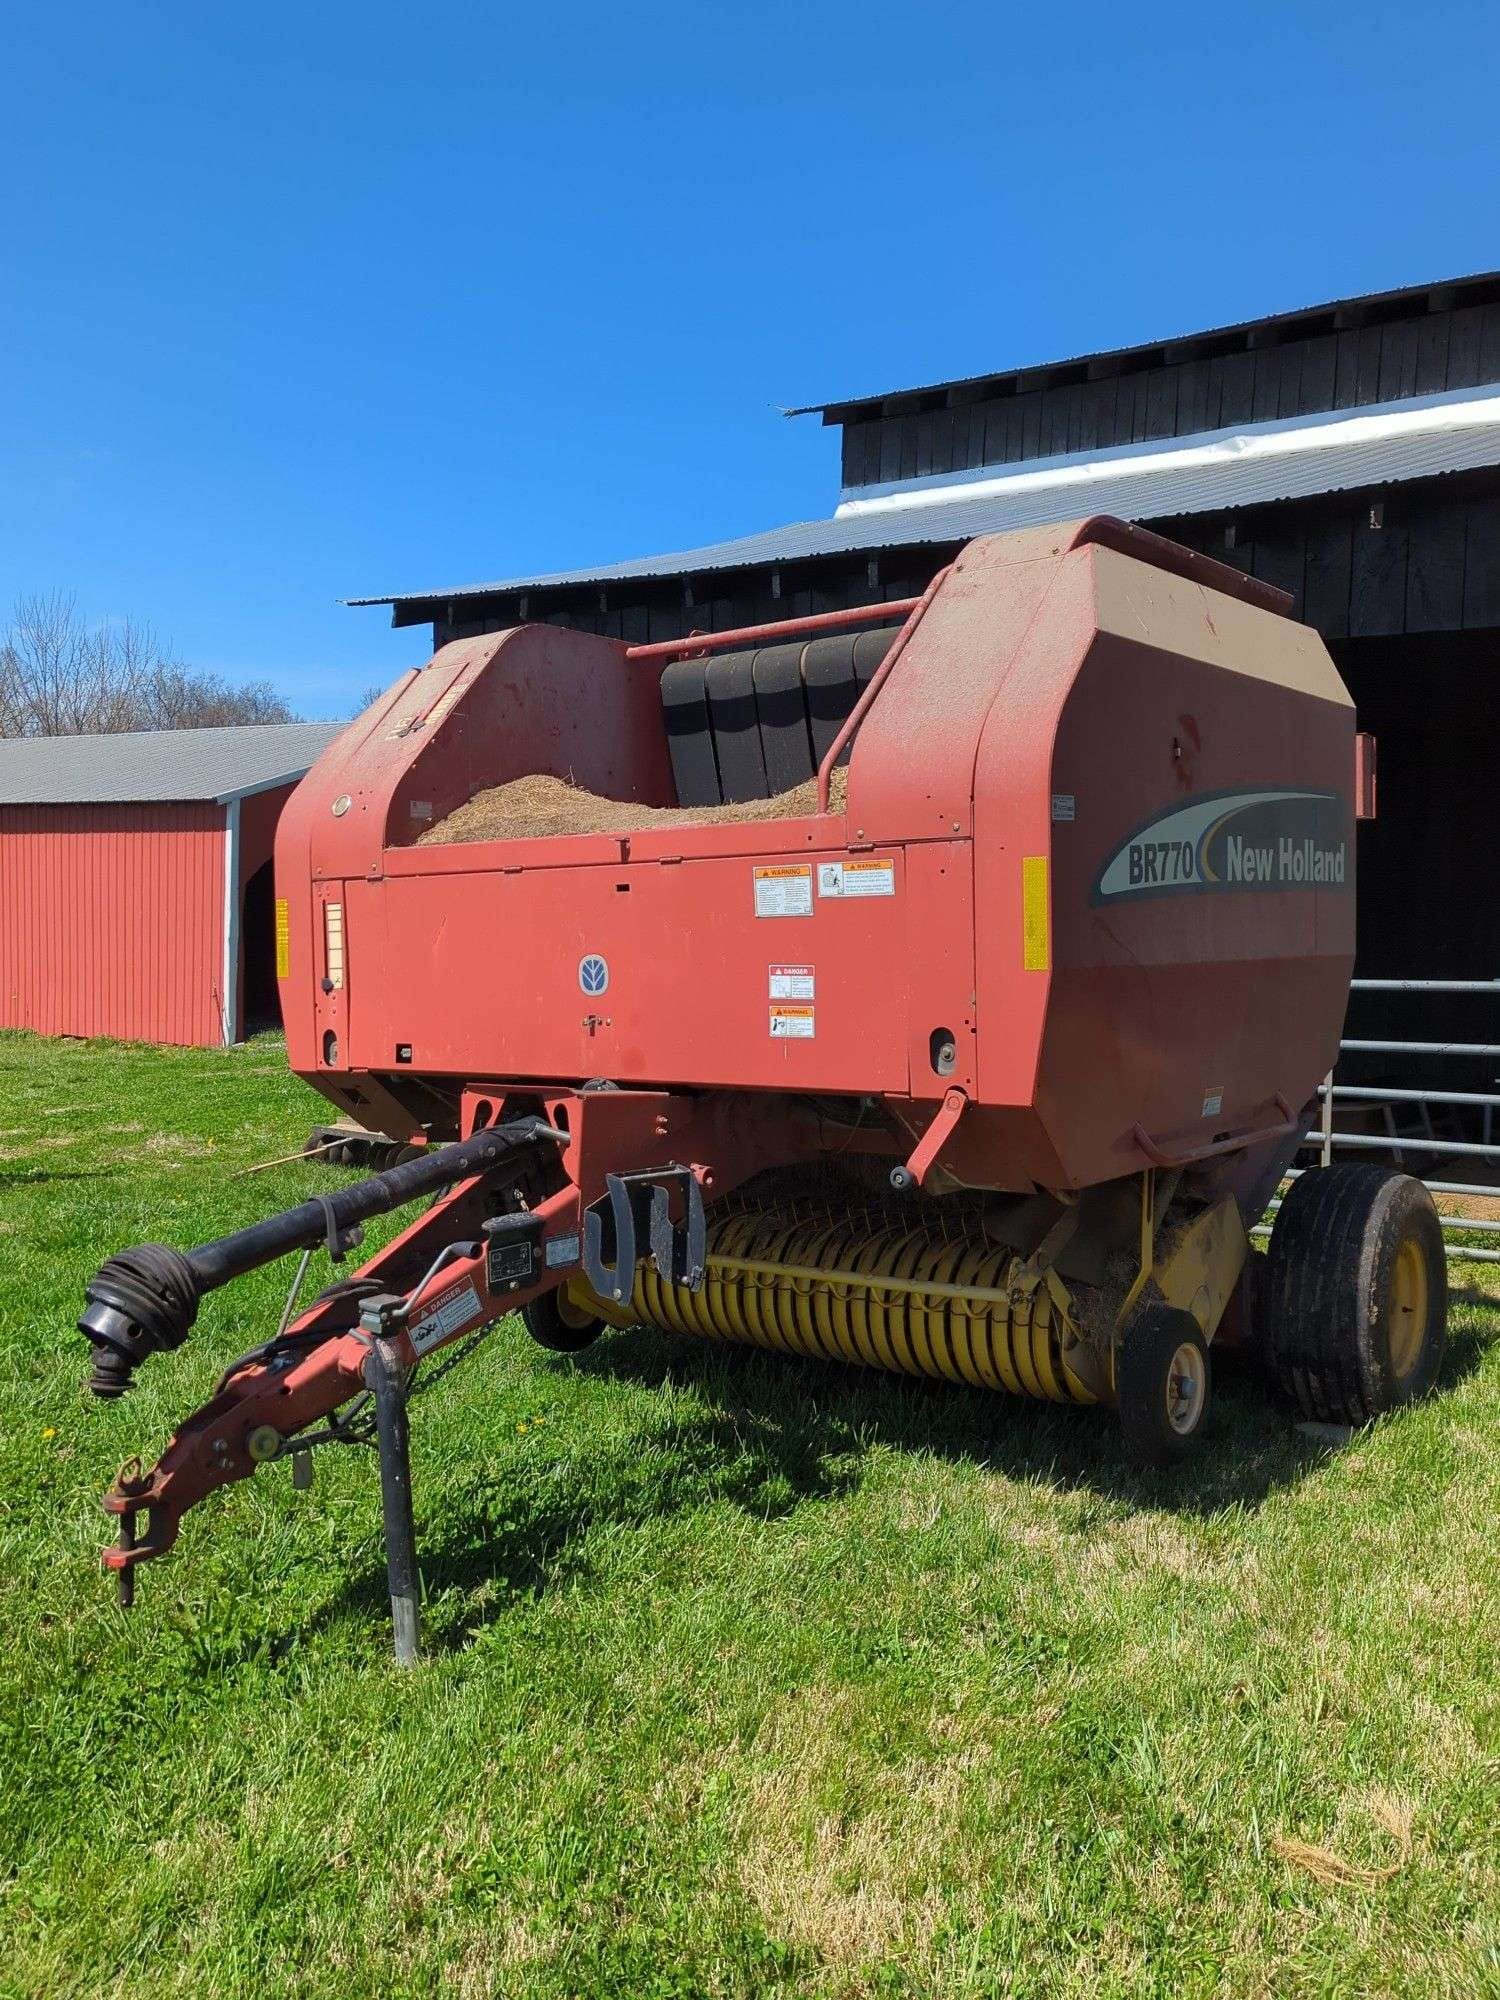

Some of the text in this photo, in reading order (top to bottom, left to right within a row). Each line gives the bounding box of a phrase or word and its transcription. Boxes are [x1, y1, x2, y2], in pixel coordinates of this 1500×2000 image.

[771, 868, 801, 876] WARNING
[1128, 835, 1345, 885] BR770 New Holland
[431, 1287, 462, 1311] DANGER
